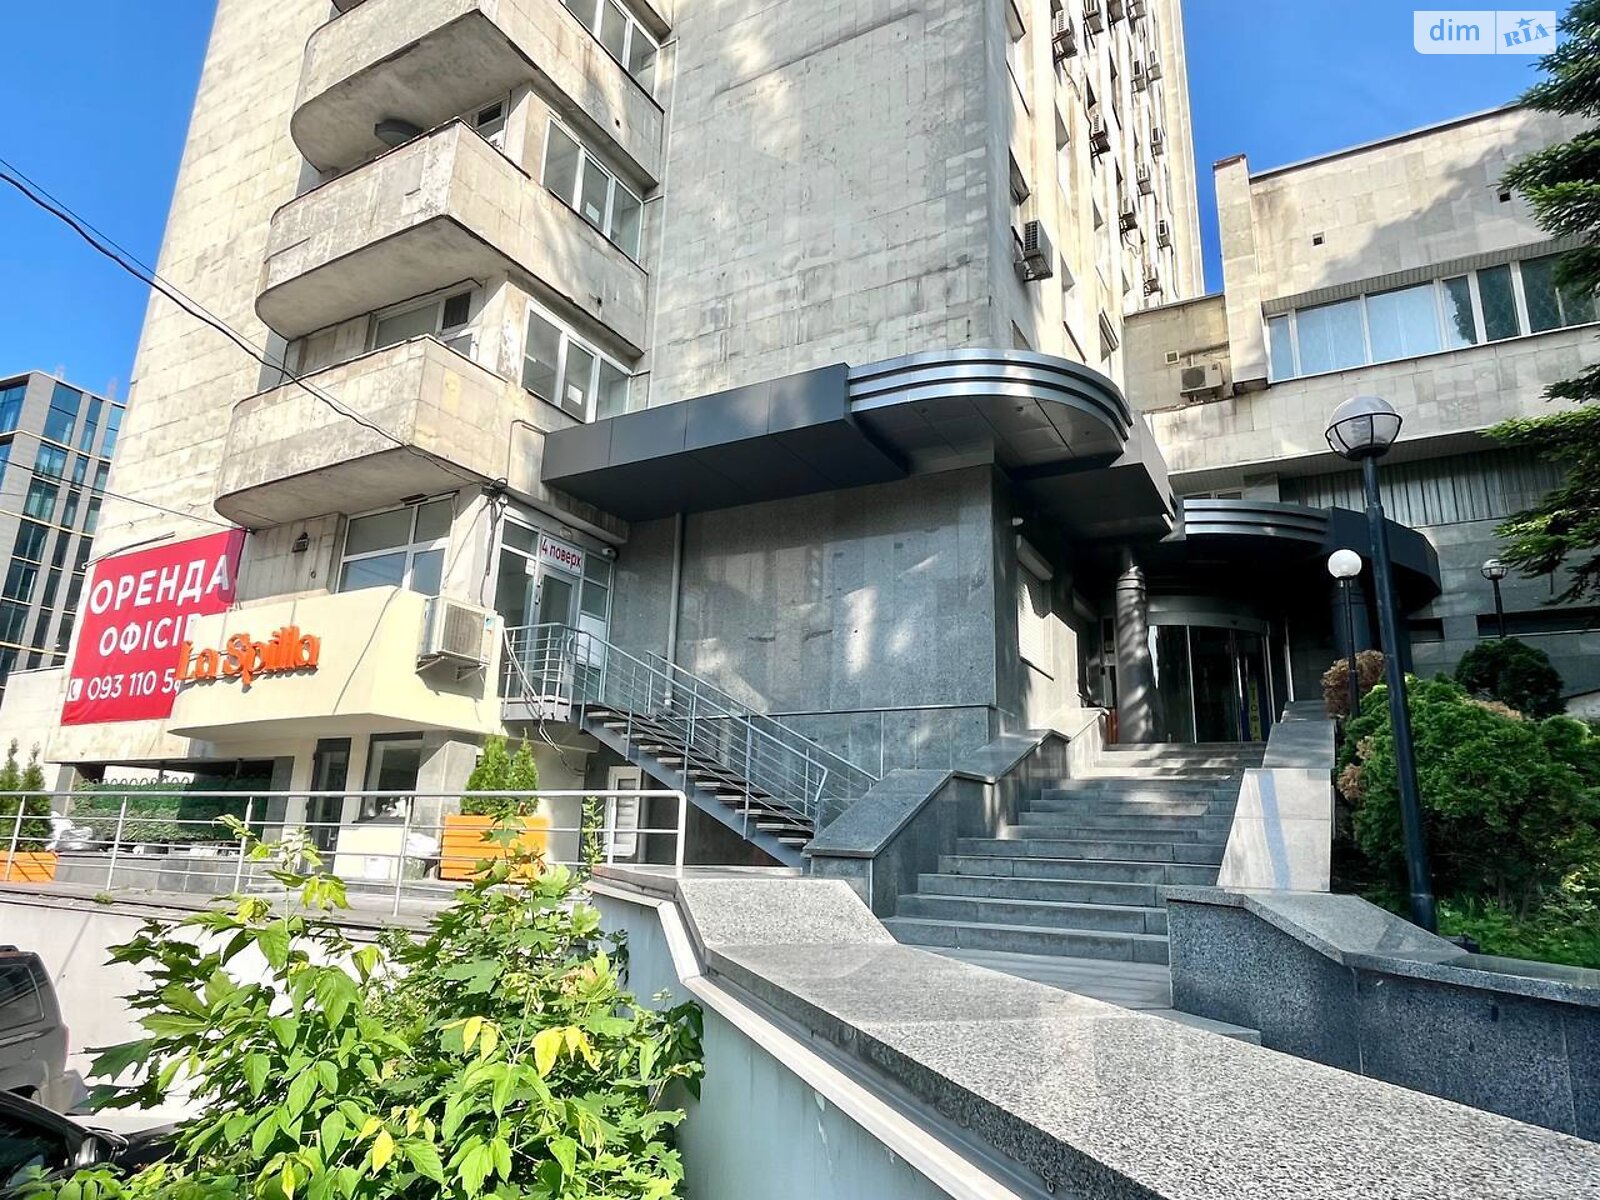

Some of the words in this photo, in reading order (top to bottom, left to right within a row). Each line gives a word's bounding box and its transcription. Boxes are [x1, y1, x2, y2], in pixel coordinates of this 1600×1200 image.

[541, 538, 547, 555] 4
[549, 545, 581, 569] поверх
[90, 554, 229, 615] ОРЕНДА
[175, 640, 218, 681] La
[222, 624, 321, 686] Spilla
[87, 674, 124, 701] 093
[129, 670, 157, 696] 110
